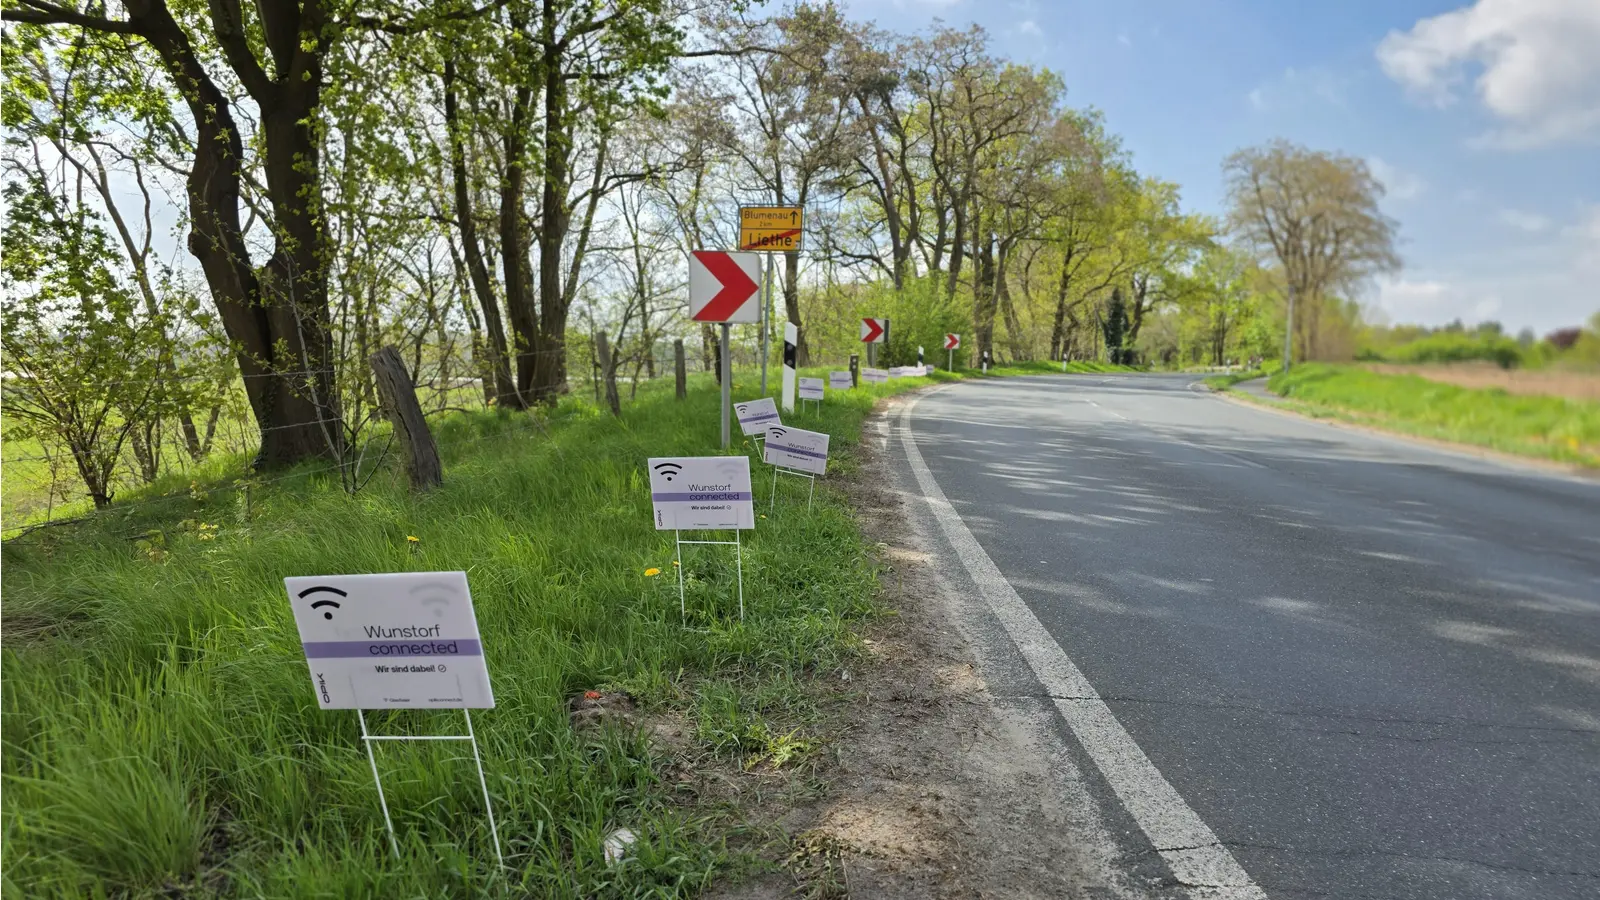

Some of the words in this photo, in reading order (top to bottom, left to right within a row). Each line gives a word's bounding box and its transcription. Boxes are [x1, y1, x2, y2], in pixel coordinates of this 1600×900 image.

[744, 210, 788, 219] Blumenau
[749, 232, 792, 246] Liethe
[787, 441, 815, 452] Wunstorf
[688, 483, 731, 492] Wunstorf
[689, 493, 740, 501] connected
[363, 624, 441, 639] Wunstorf
[369, 641, 459, 656] connected
[375, 664, 390, 673] Wir
[390, 664, 409, 673] sind
[410, 664, 436, 673] dabei!
[316, 672, 331, 704] OPIK
